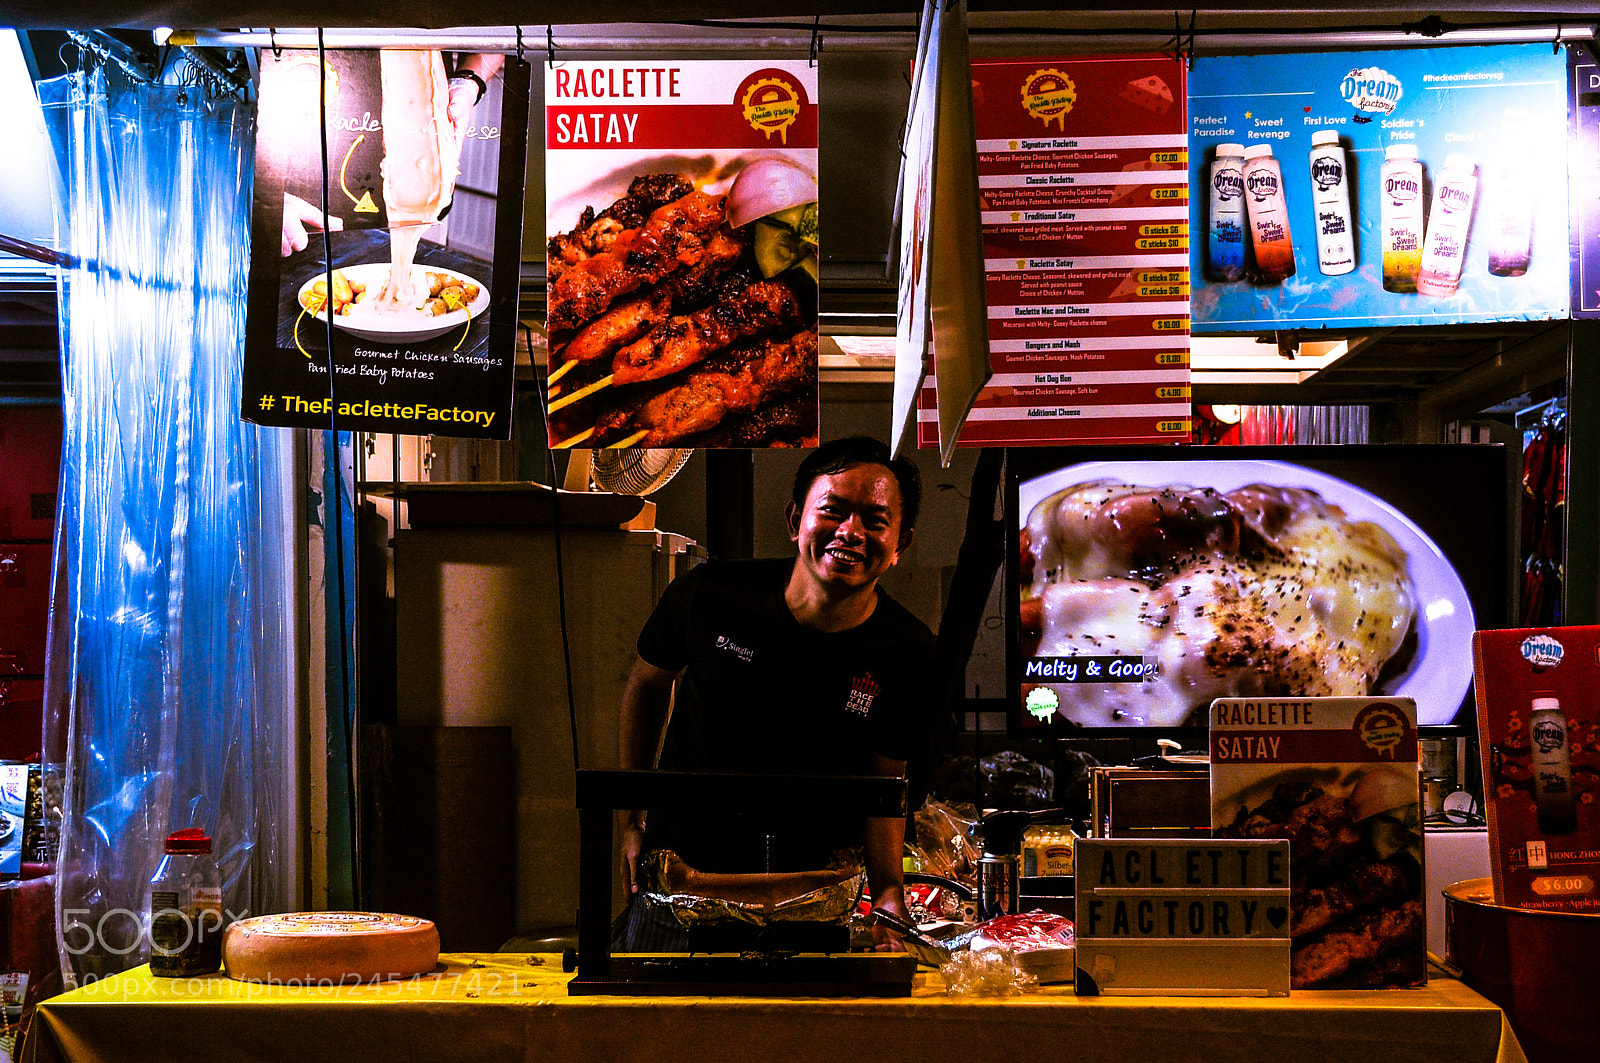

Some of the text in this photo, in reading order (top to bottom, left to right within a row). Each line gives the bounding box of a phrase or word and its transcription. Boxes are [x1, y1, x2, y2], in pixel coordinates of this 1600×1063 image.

[556, 68, 681, 97] RACLETTE
[1422, 72, 1504, 83] #thedreamfactorysg
[1343, 77, 1399, 101] Dream
[1359, 97, 1396, 115] factory
[1194, 115, 1228, 125] Perfect
[1254, 117, 1284, 127] Sweet
[1303, 116, 1347, 125] First Love
[556, 113, 639, 143] SATAY
[1194, 127, 1235, 137] Paradise
[1247, 130, 1290, 140] Revenge
[1390, 130, 1415, 140] Pride
[1444, 131, 1475, 143] Cloud
[1021, 139, 1078, 149] Signature Raclette
[1312, 164, 1341, 179] Dream
[1026, 175, 1074, 184] Classic Raclette
[1249, 175, 1278, 190] Dream
[1387, 178, 1418, 195] Dream
[1441, 186, 1470, 206] Dream
[1024, 211, 1076, 220] Traditional Satay
[1319, 211, 1335, 221] Swirl
[1256, 220, 1273, 230] Swirl
[1144, 227, 1149, 235] 6
[1150, 226, 1168, 235] sticks
[1390, 228, 1408, 237] Swirl
[1140, 240, 1147, 248] 12
[1148, 240, 1167, 248] sticks
[1392, 243, 1418, 251] Dreams
[1056, 259, 1074, 268] Satay
[1149, 273, 1168, 282] sticks
[1149, 287, 1168, 295] sticks
[1014, 306, 1089, 316] Raclette Mac and Cheese
[1025, 340, 1081, 350] Bangers and Mash
[355, 348, 503, 371] Gourmet Chicken Sausages
[308, 362, 435, 384] Pan ried Baby Potatoes
[1035, 374, 1072, 383] Hot Dog Bun
[1027, 408, 1081, 417] Additional Cheese
[1523, 641, 1562, 660] Dream
[1025, 658, 1079, 681] Melty
[1085, 659, 1102, 677] &
[850, 689, 875, 703] RACE
[849, 695, 872, 708] THE
[845, 700, 869, 714] DEAD
[1216, 702, 1313, 726] RACLETTE
[1534, 726, 1564, 741] Dream
[1217, 736, 1281, 760] SATAY
[1550, 850, 1600, 860] HONG ZHO
[1520, 899, 1563, 909] Strawberry
[1088, 900, 1258, 935] FACTORY
